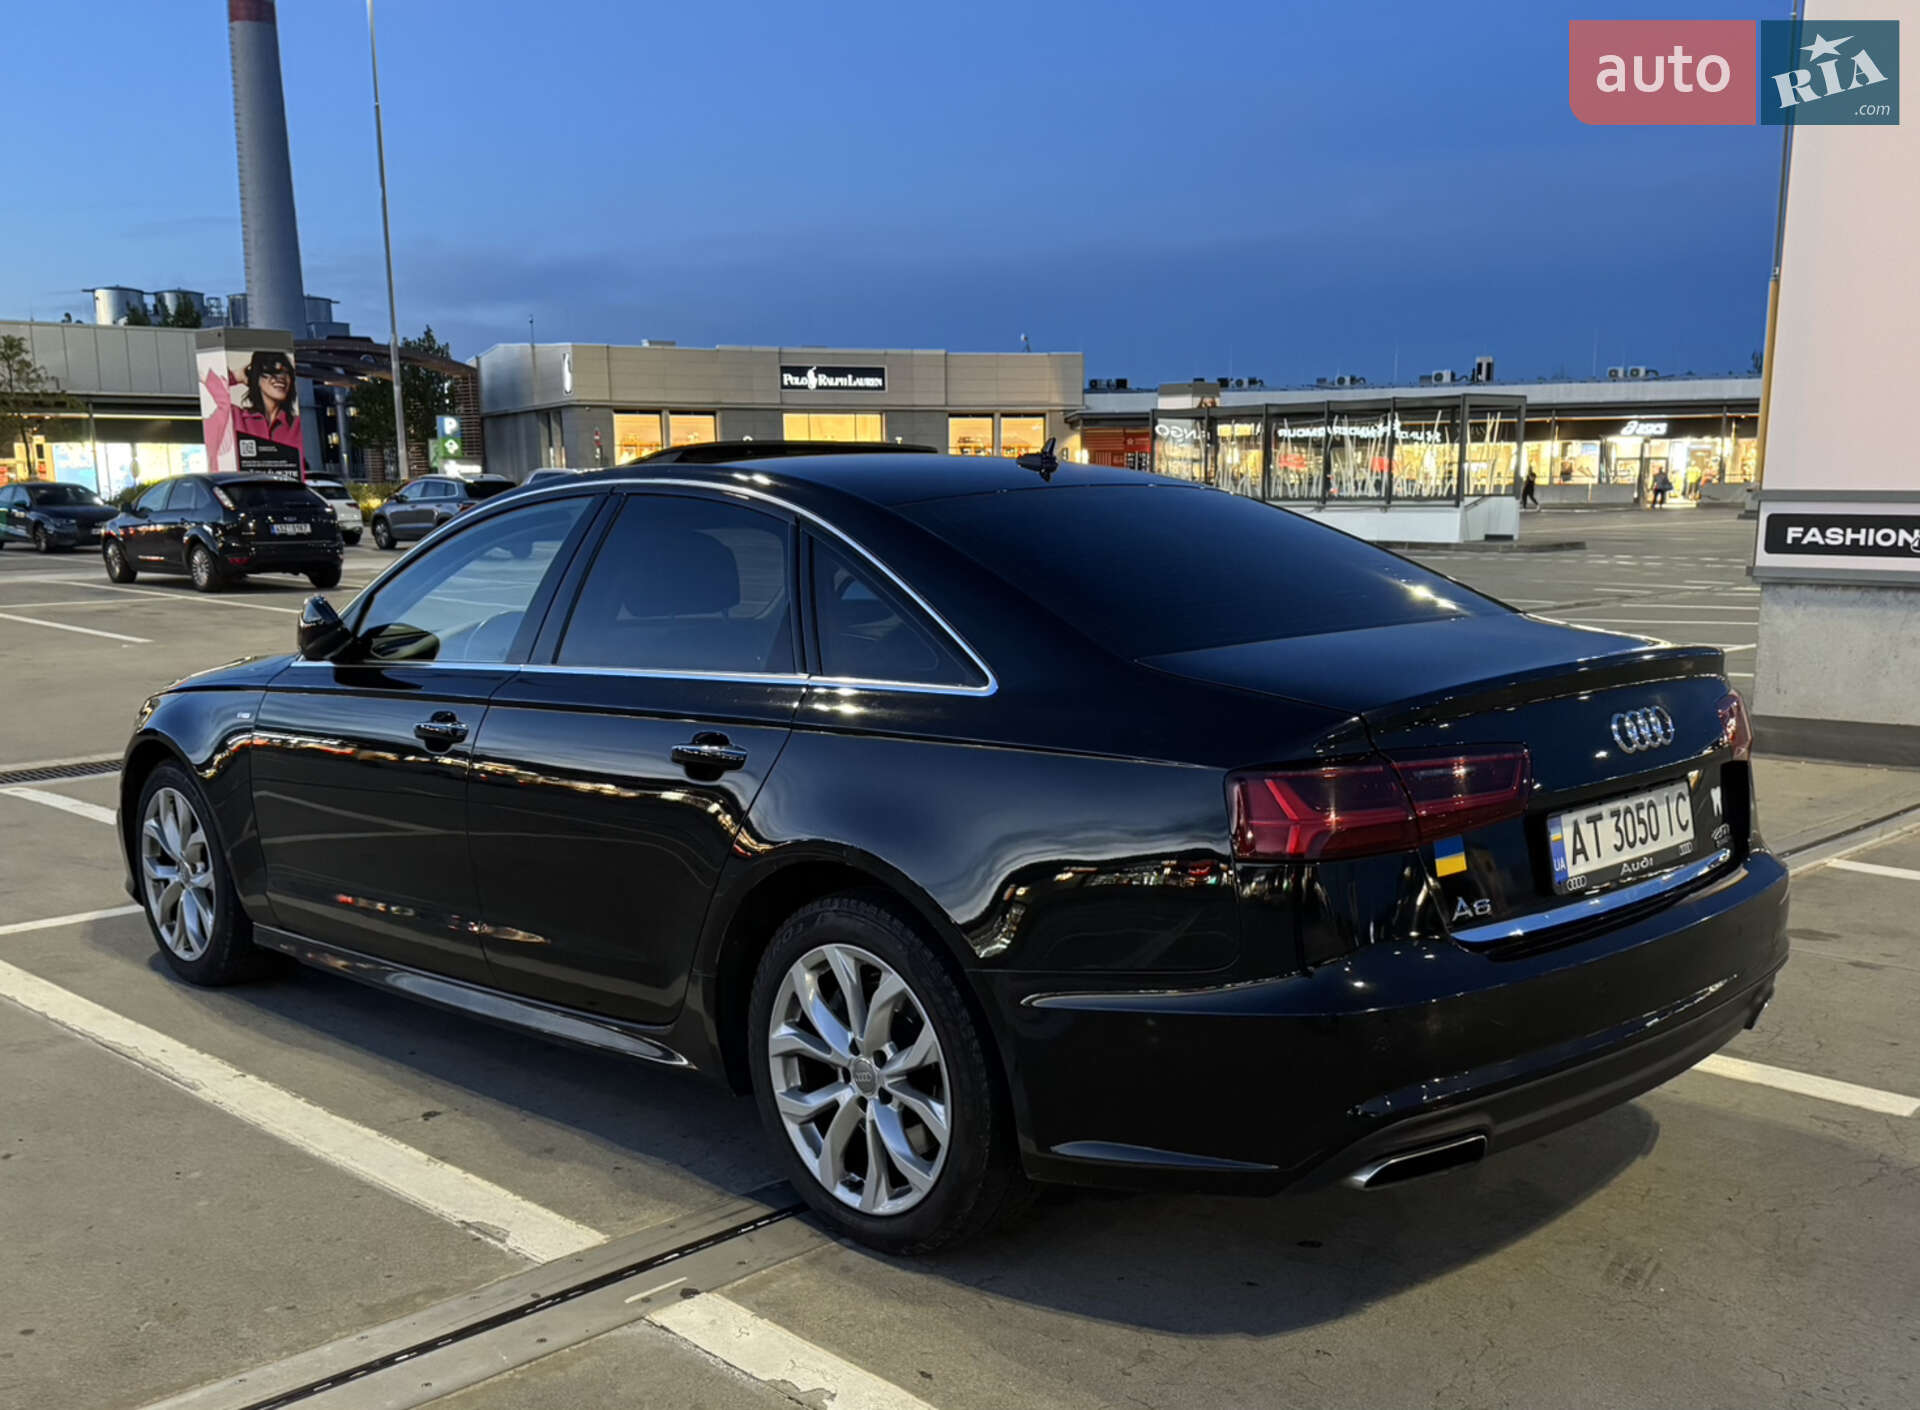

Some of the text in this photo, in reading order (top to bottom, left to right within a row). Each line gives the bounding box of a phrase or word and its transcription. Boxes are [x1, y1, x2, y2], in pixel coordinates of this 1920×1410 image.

[443, 416, 457, 435] P
[1786, 526, 1920, 547] FASHION
[1571, 792, 1690, 866] AT 3050 IC
[1553, 857, 1567, 872] UA
[1620, 857, 1653, 876] Audi
[1452, 897, 1491, 921] A6
